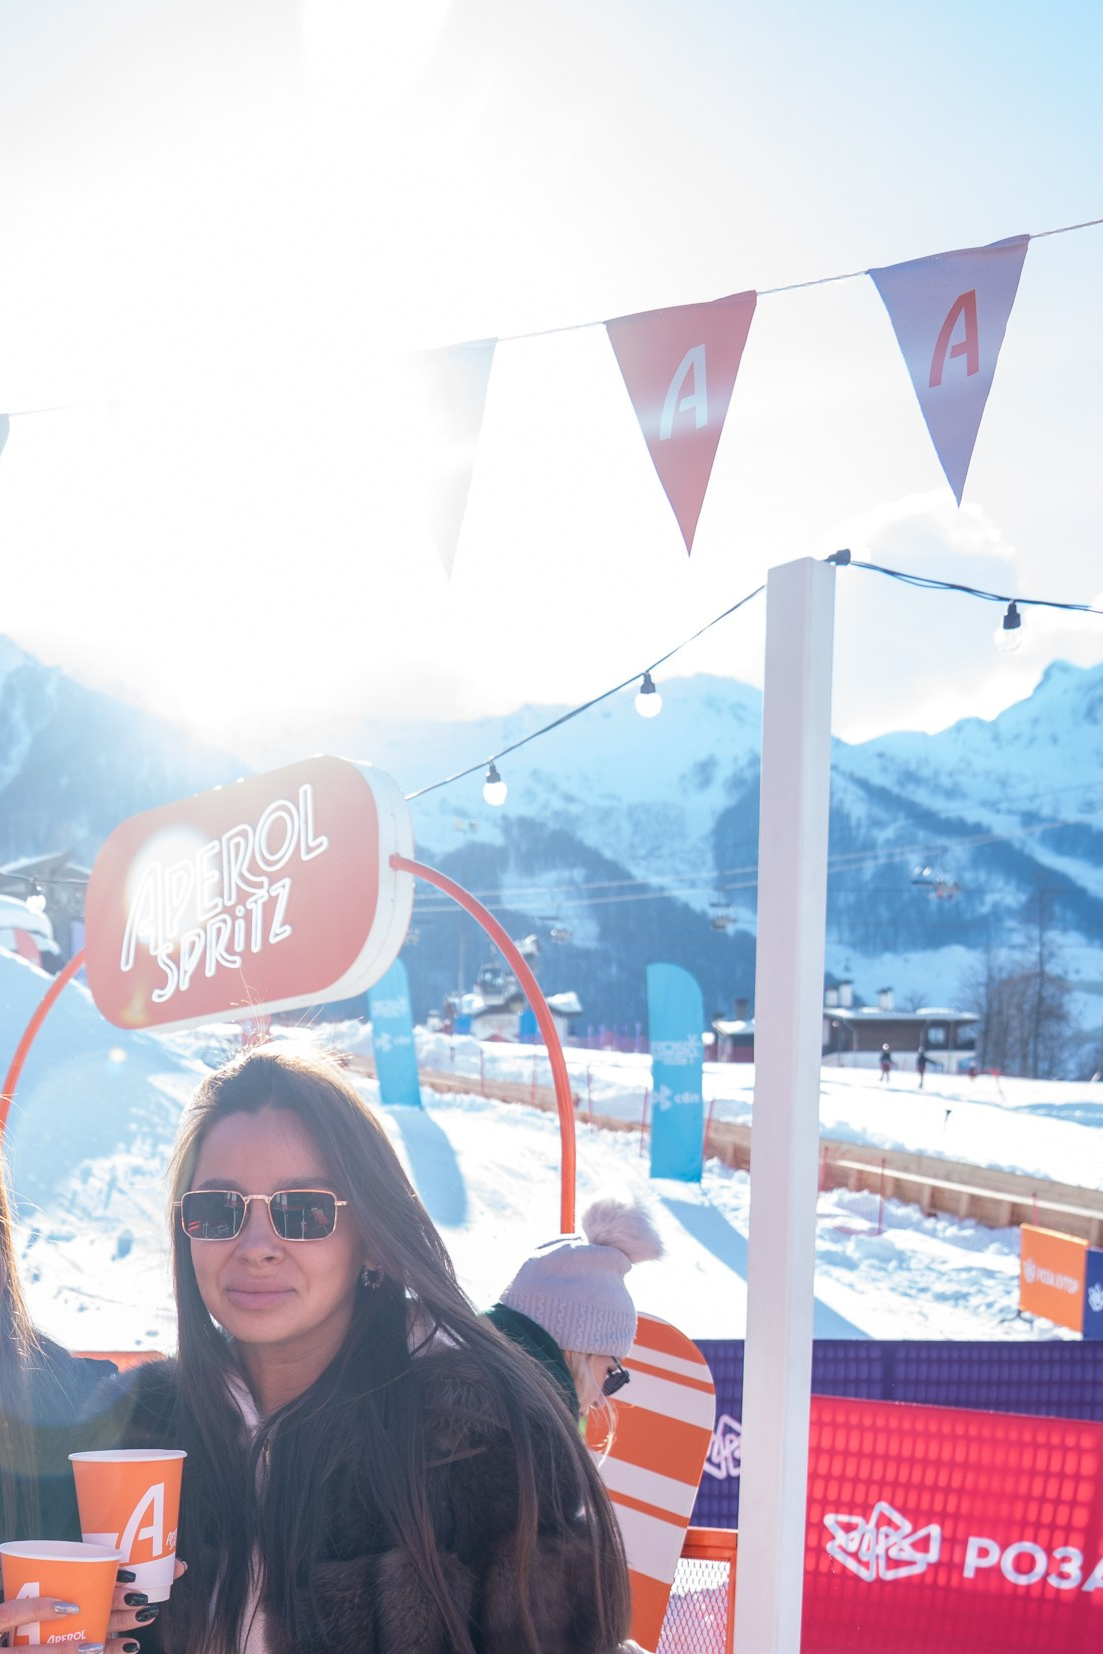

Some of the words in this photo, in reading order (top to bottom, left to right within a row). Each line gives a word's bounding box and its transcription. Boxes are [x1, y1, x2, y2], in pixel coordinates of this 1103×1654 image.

[928, 288, 980, 389] A
[658, 343, 709, 441] A
[121, 783, 328, 972] APEROL
[119, 1482, 164, 1564] A
